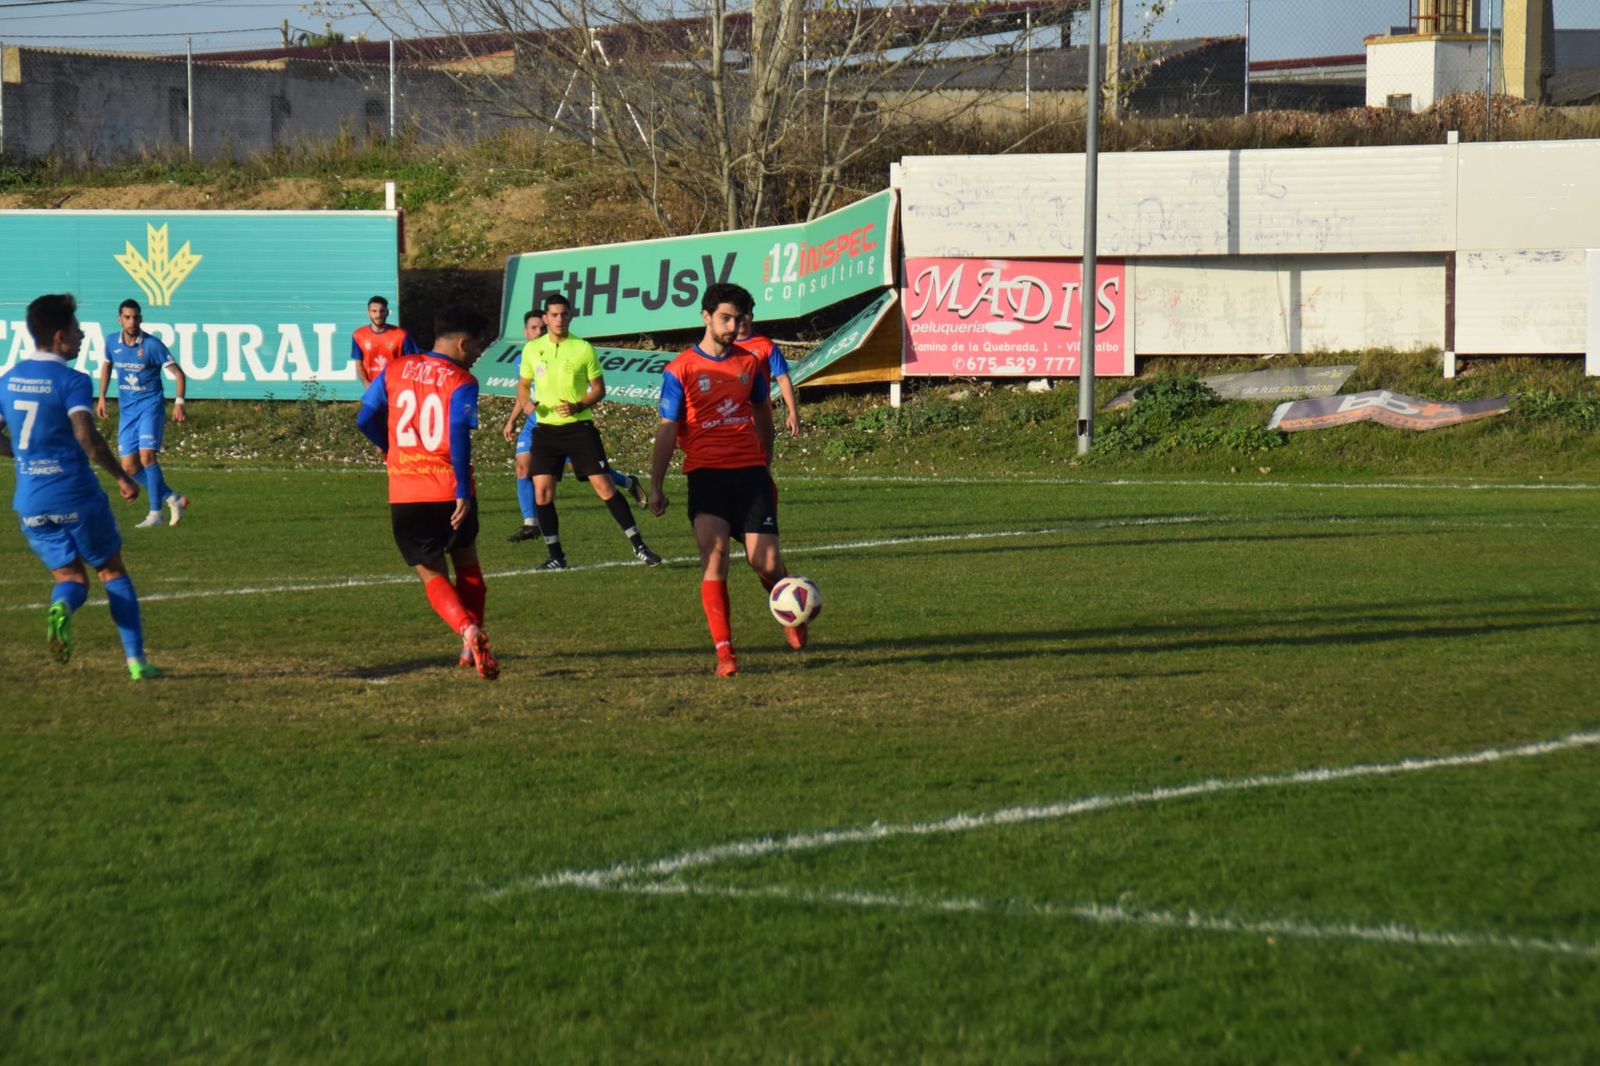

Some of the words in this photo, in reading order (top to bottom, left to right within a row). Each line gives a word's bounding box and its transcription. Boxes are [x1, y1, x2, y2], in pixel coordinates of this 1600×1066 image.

[764, 256, 875, 301] consulting
[911, 342, 947, 352] Camino
[951, 341, 964, 351] de
[969, 341, 979, 351] la
[982, 341, 1039, 353] Quebrada,
[966, 356, 997, 371] 675
[1006, 357, 1036, 371] 529
[1044, 357, 1075, 371] 777
[13, 399, 39, 449] 7
[395, 390, 444, 452] 20
